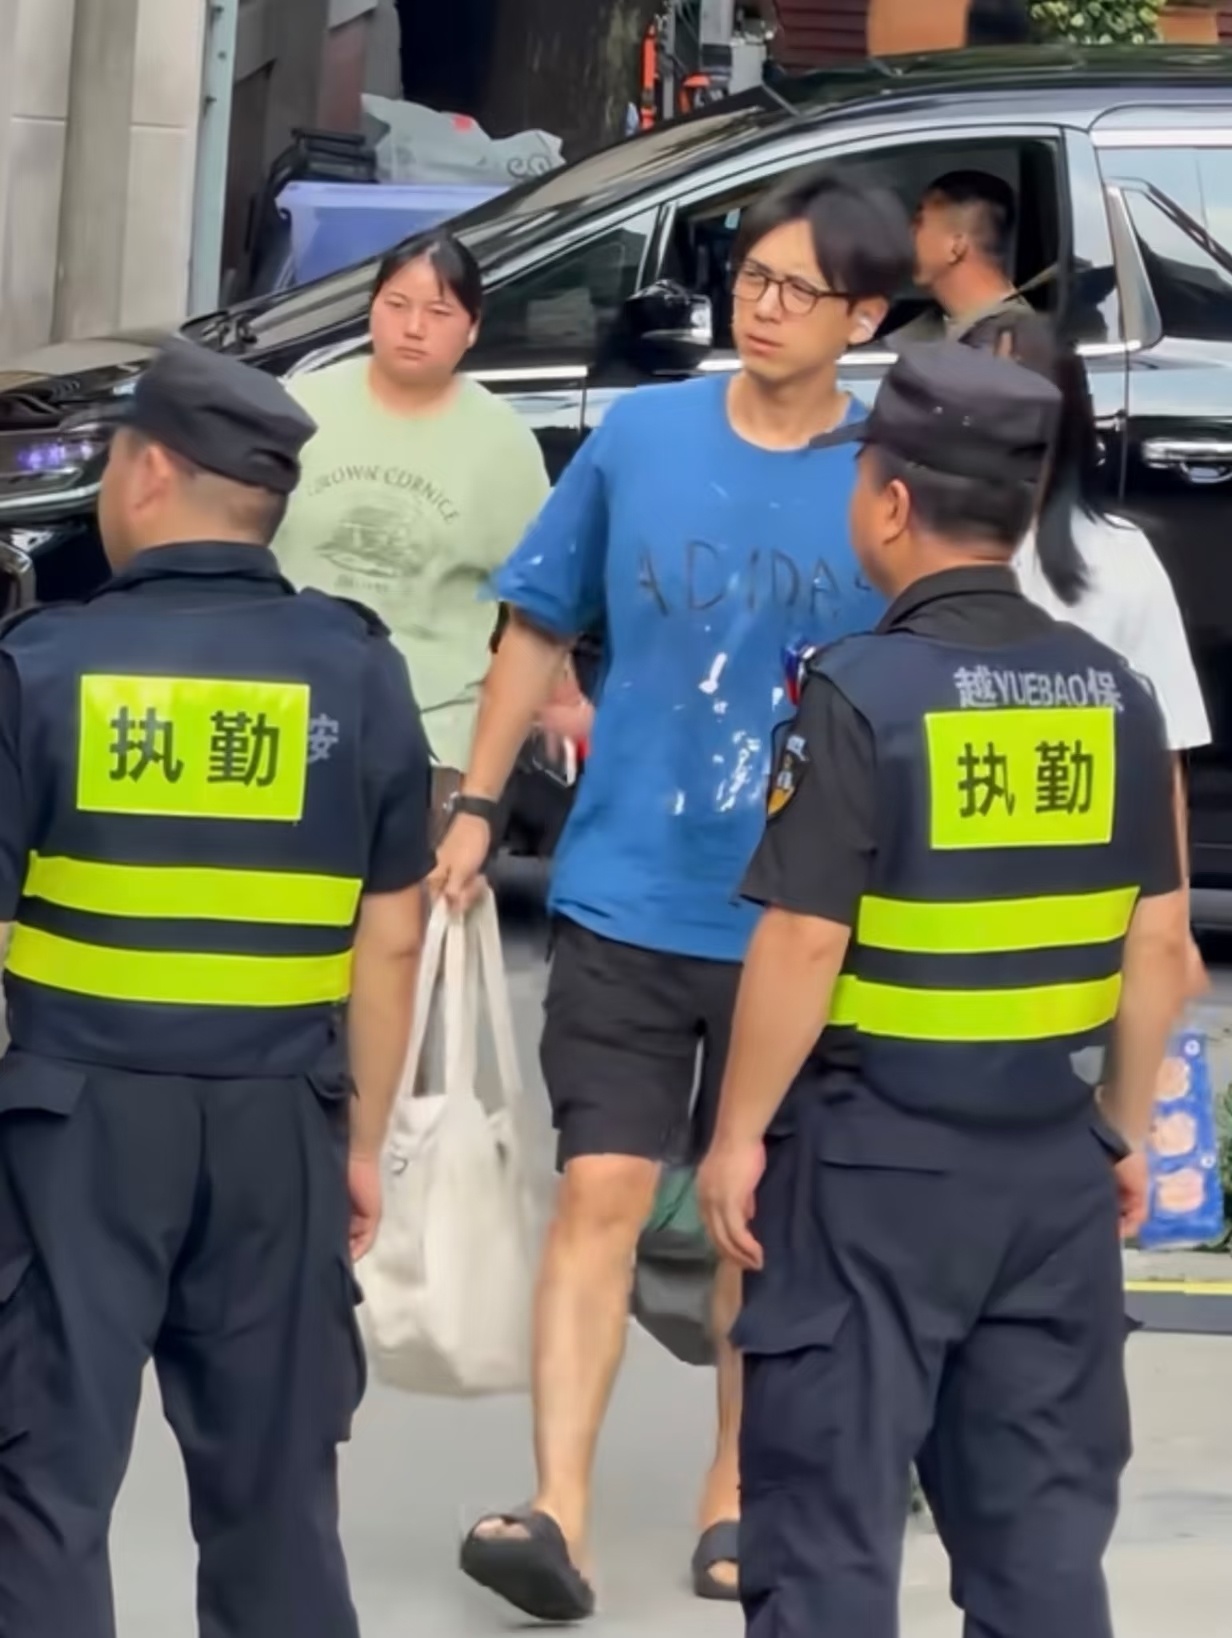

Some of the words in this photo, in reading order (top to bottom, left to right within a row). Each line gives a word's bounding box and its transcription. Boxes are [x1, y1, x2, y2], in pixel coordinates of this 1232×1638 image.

[109, 706, 280, 787] 执勤
[307, 713, 339, 764] 安
[957, 740, 1094, 818] 执勤
